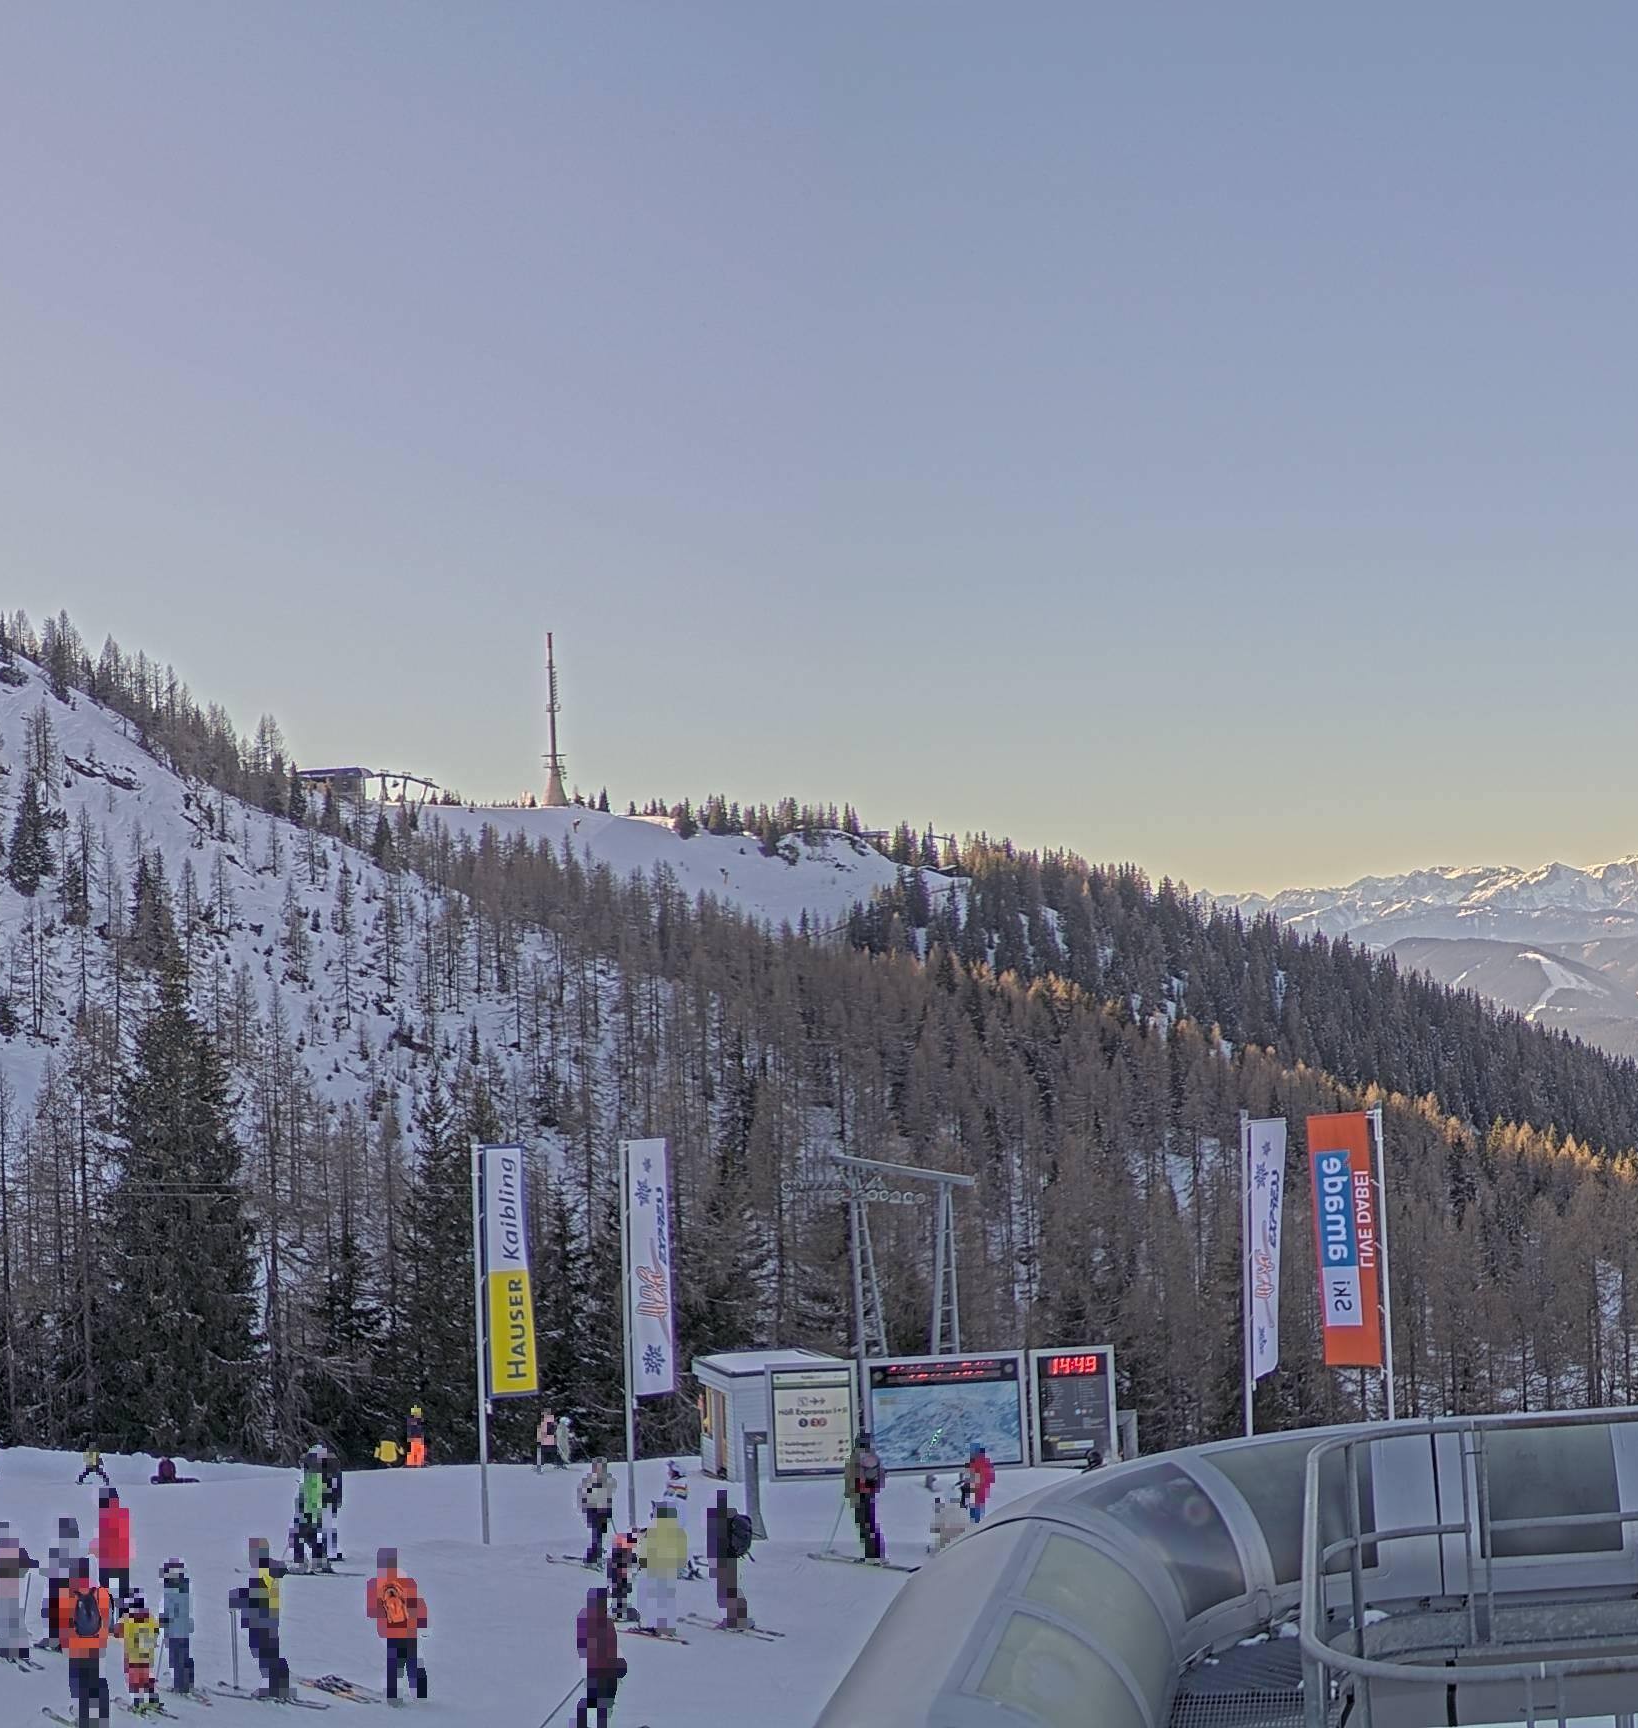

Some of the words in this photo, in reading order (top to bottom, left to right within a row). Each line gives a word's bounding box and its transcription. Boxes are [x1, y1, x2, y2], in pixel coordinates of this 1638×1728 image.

[498, 1156, 520, 1261] Kaibling
[506, 1278, 527, 1379] HAUSER
[1051, 1355, 1097, 1375] 14:49
